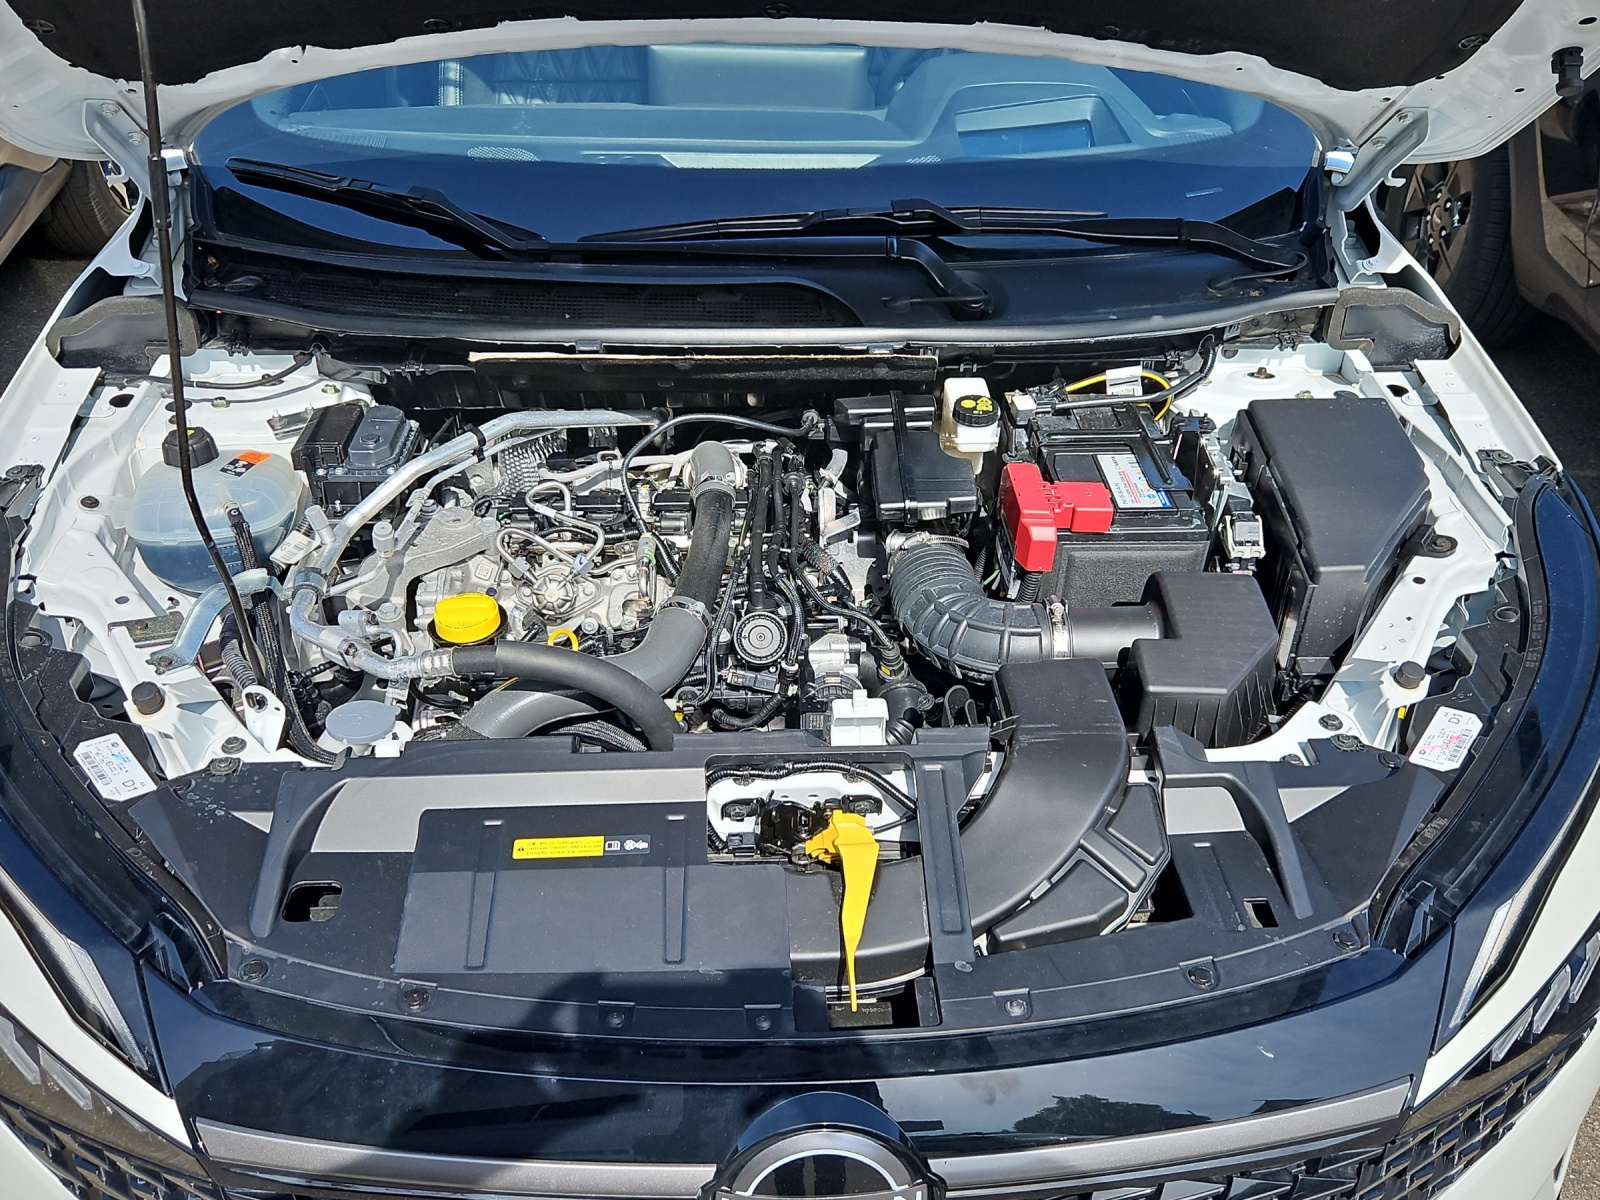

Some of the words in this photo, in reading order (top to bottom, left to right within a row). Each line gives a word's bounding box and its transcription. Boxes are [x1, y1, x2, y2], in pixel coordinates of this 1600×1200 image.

[1114, 482, 1128, 504] NISSAN
[1448, 713, 1463, 724] D1
[122, 779, 138, 792] D1
